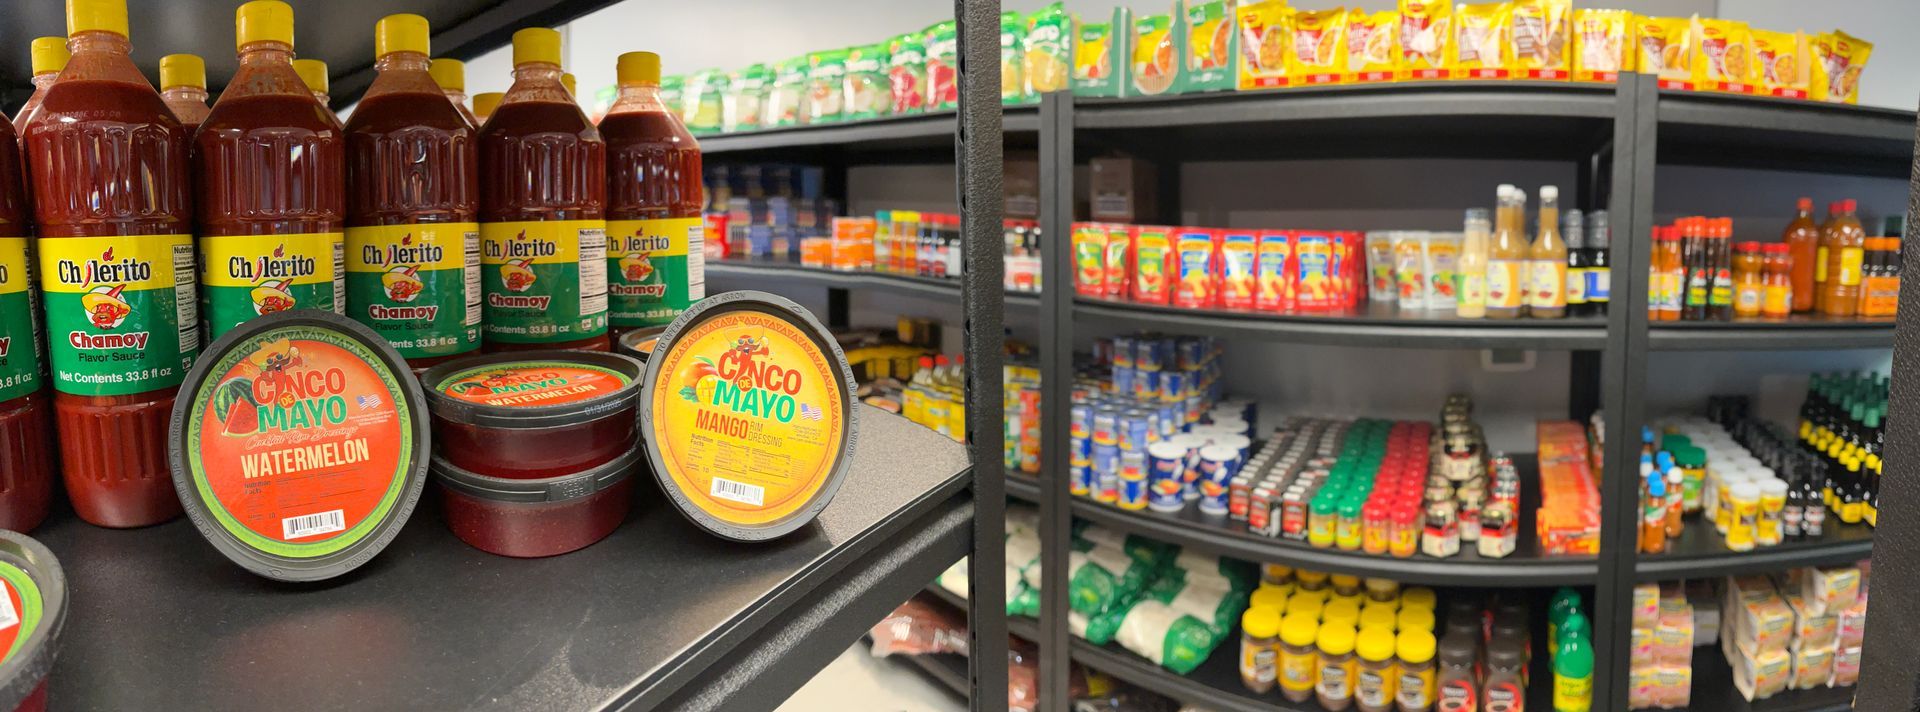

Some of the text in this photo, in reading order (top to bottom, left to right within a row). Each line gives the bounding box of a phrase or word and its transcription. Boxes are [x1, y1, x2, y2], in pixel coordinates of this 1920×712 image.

[363, 243, 442, 268] Chilerito
[58, 258, 151, 288] Chilerito
[229, 255, 314, 282] Chilerito
[608, 283, 666, 297] Chamoy
[489, 293, 551, 310] Chamoy
[369, 305, 438, 321] Chamoy
[375, 322, 434, 331] Flavor Sauce
[490, 325, 526, 334] Contents
[529, 325, 549, 334] 33.8
[69, 331, 149, 350] Chamoy
[416, 338, 436, 348] 33.8
[439, 338, 446, 346] fl
[78, 352, 145, 362] Flavor Sauce
[15, 374, 21, 384] fl
[22, 373, 32, 382] oz
[60, 368, 172, 383] Net Contents 33.8 fl oz
[718, 350, 802, 396] CINCO
[252, 367, 346, 404] CINCO
[490, 378, 568, 394] MAYO
[740, 379, 752, 389] DE
[280, 394, 293, 406] DE
[484, 384, 598, 406] WATERMELON
[712, 380, 796, 423] MAYO
[256, 395, 348, 433] MAYO
[696, 409, 764, 440] MANGO RIM
[748, 431, 783, 448] DRESSING
[240, 438, 370, 479] WATERMELON
